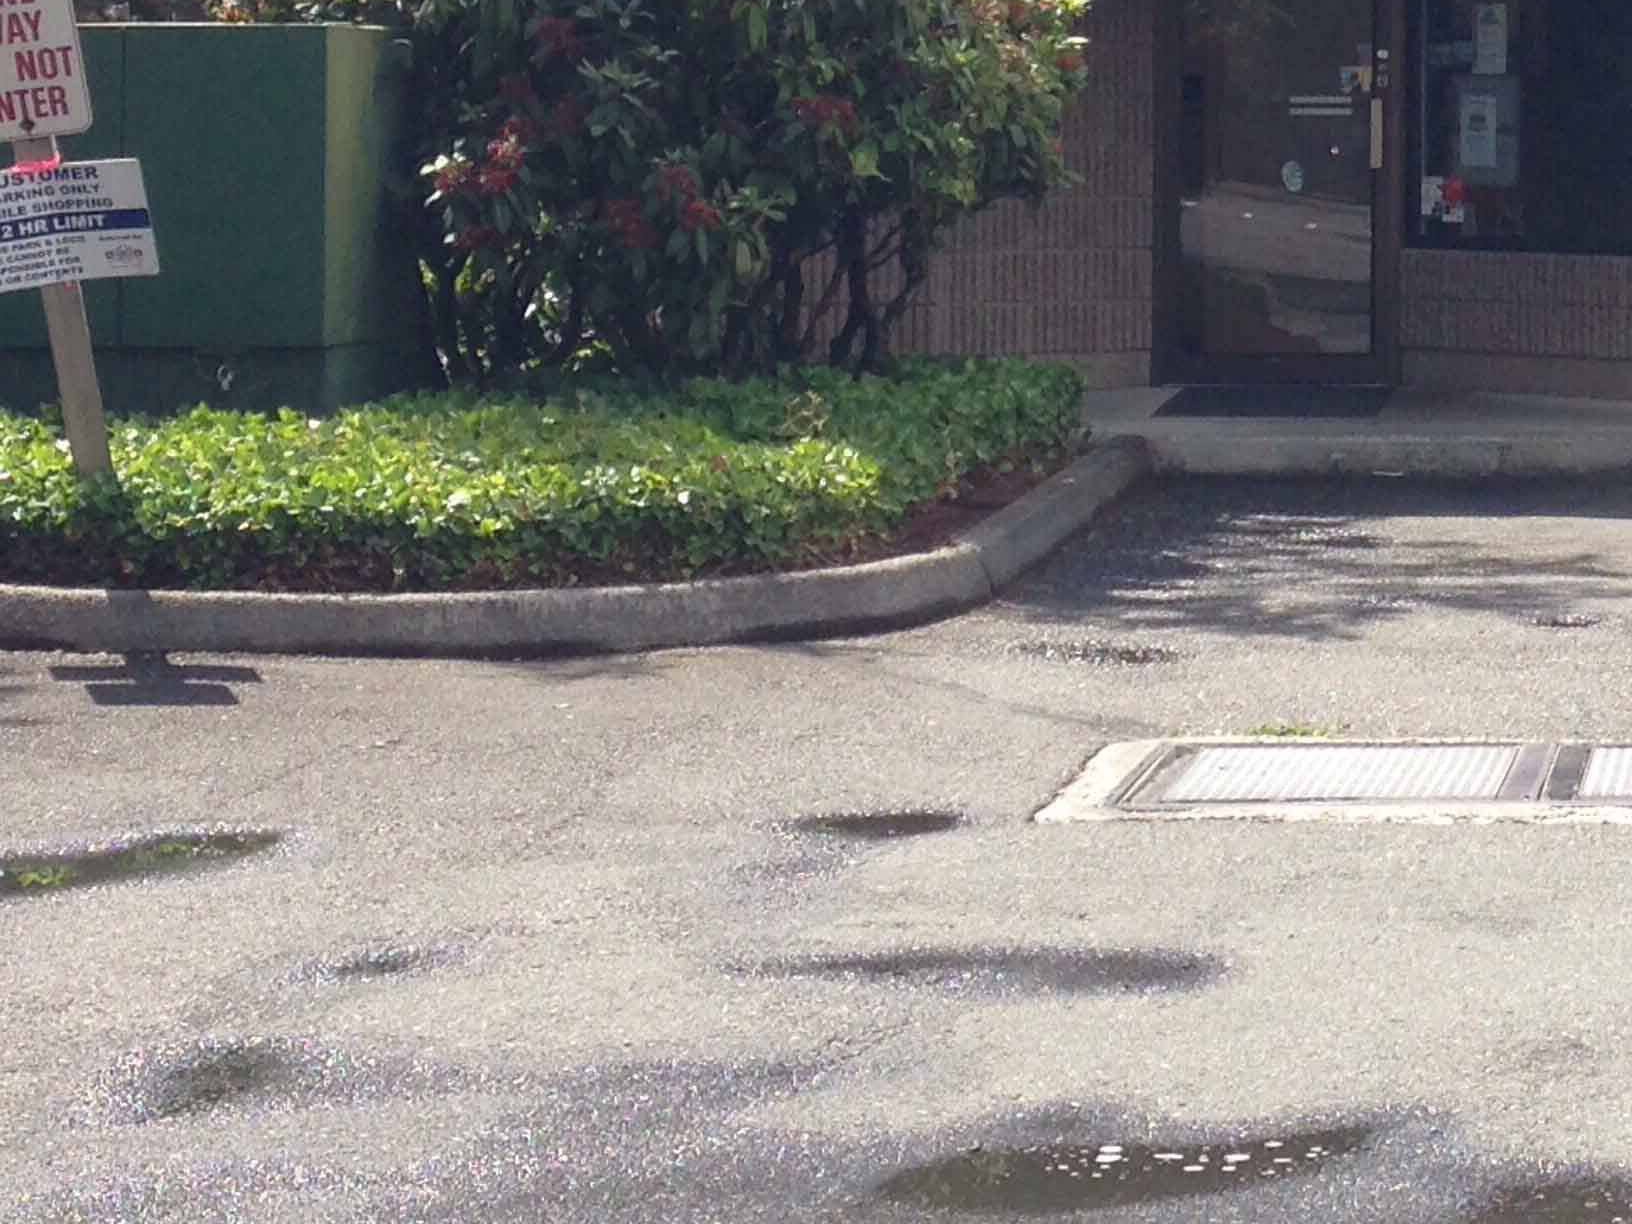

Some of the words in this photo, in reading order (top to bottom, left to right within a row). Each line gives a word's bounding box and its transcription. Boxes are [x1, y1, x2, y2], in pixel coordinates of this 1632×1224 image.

[0, 10, 41, 44] AY
[14, 46, 73, 81] NOT
[59, 183, 100, 195] ONLY
[32, 197, 114, 214] SHOPPING
[2, 226, 13, 238] 2
[18, 219, 49, 236] HR
[52, 214, 105, 231] LIMIT
